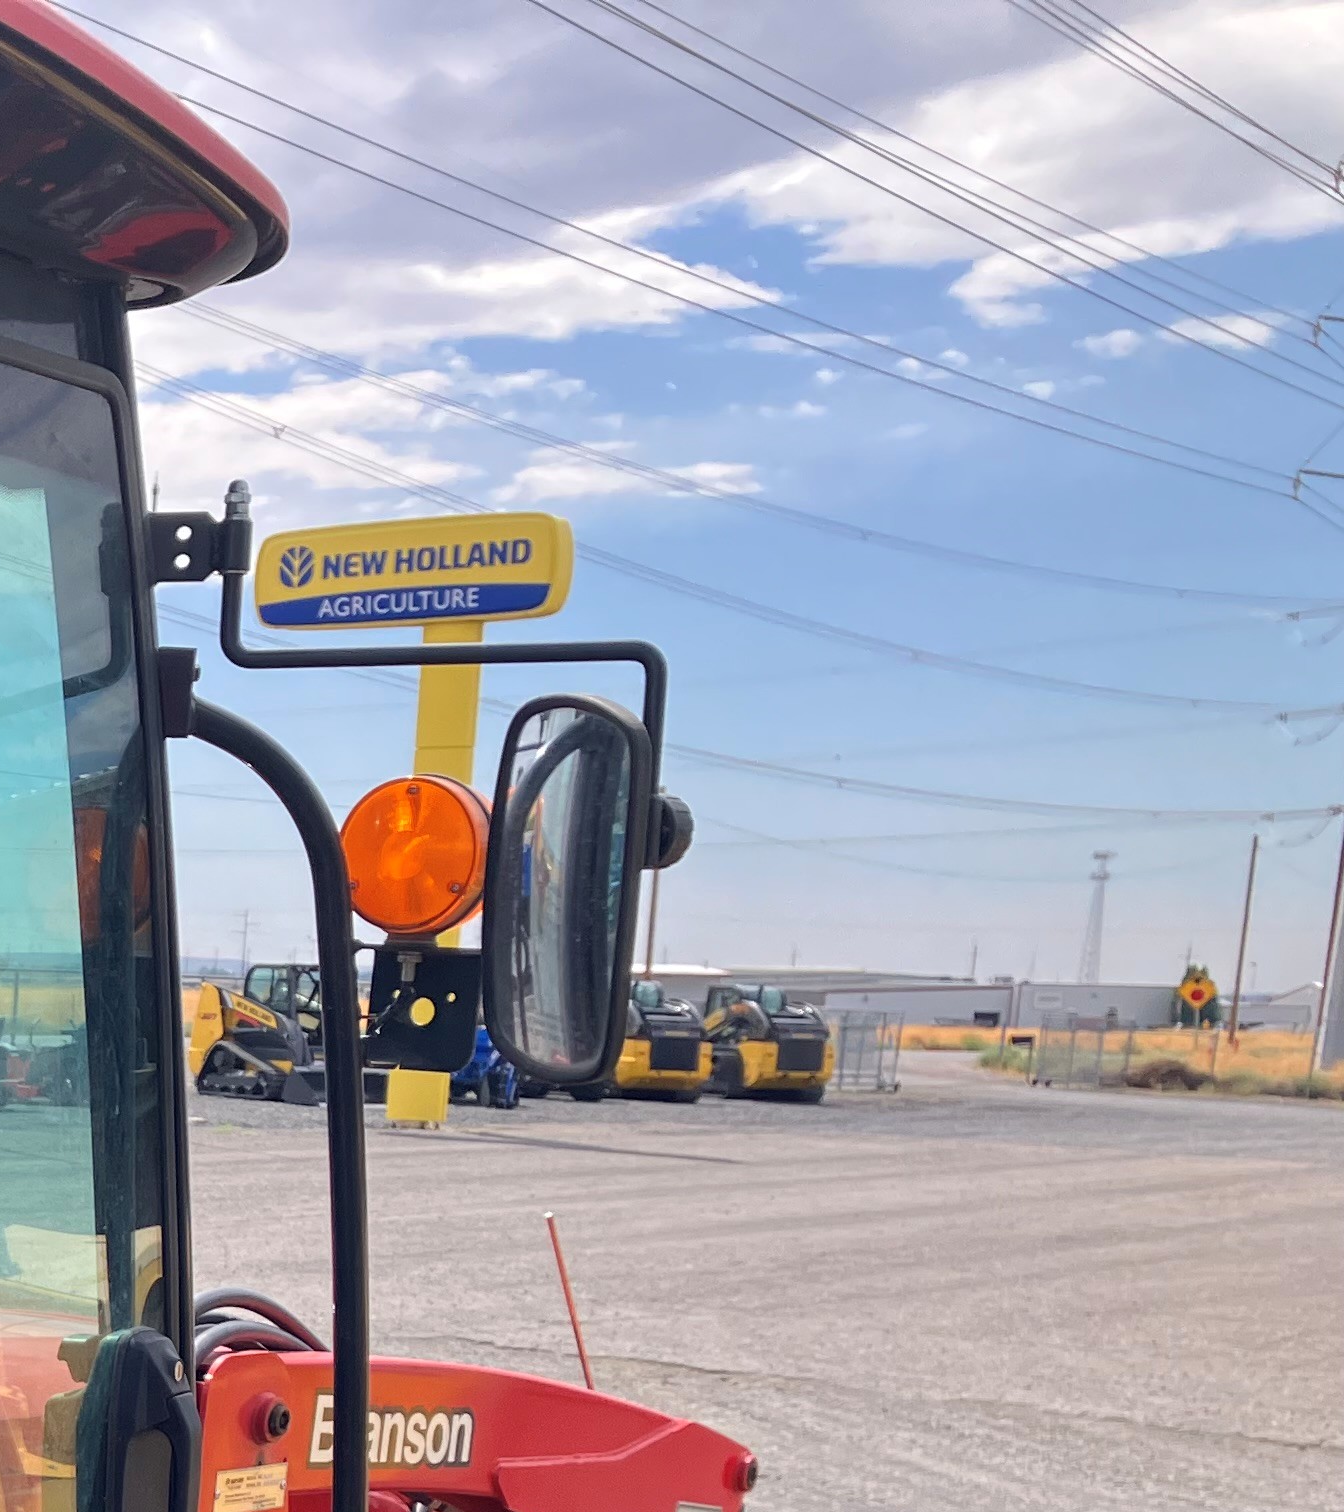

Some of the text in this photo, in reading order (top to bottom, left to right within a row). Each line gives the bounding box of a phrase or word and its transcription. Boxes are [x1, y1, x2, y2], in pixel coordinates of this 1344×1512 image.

[322, 537, 533, 579] NEW HOLLAND
[317, 586, 481, 619] AGRICULTURE
[308, 1391, 474, 1467] Banson
